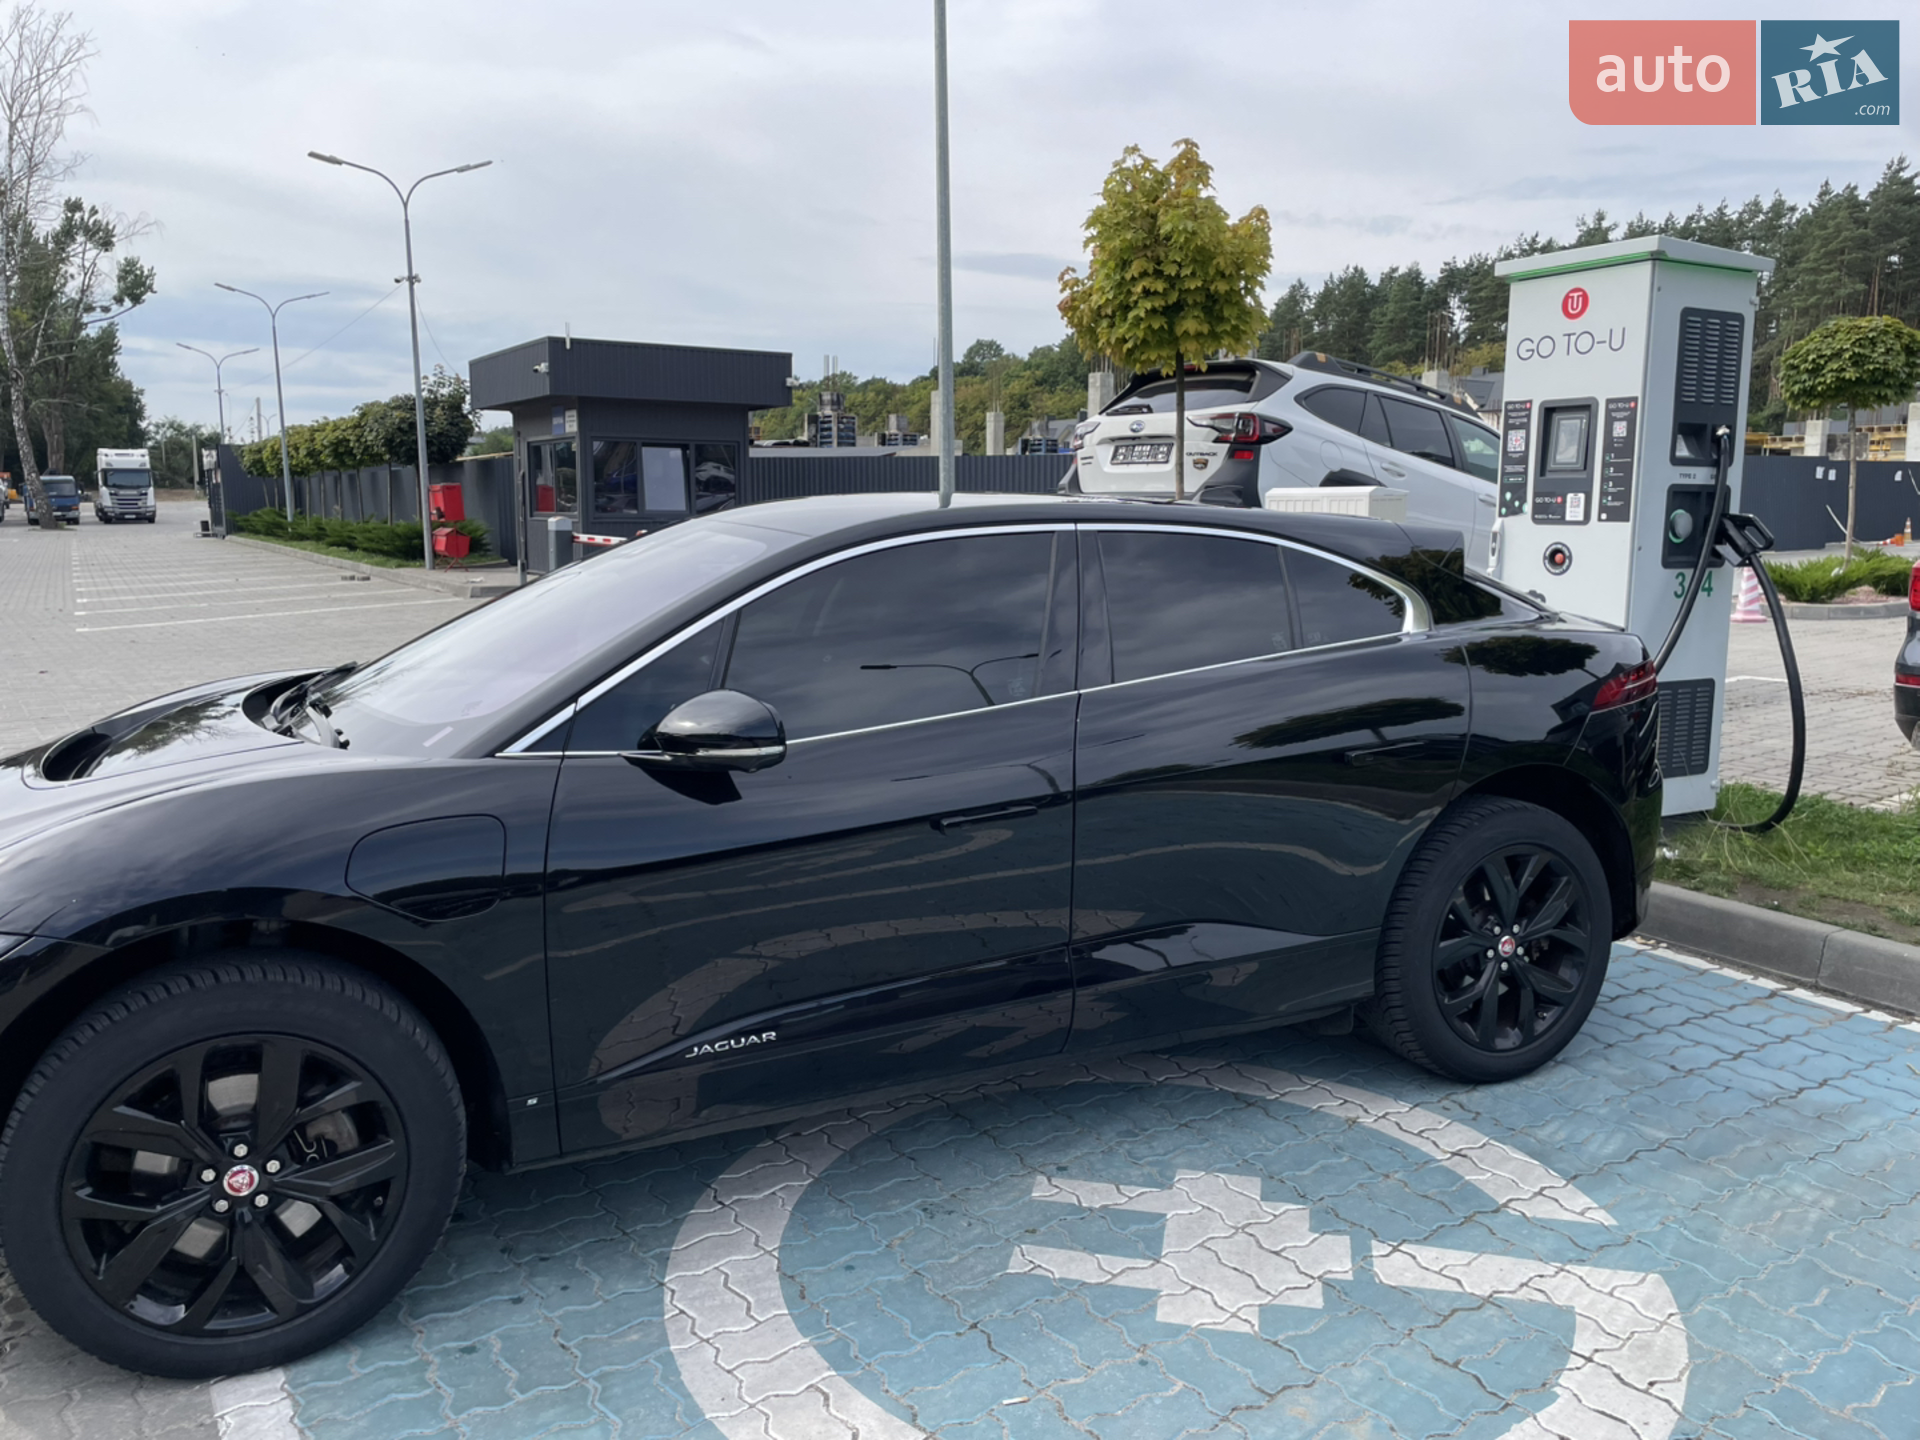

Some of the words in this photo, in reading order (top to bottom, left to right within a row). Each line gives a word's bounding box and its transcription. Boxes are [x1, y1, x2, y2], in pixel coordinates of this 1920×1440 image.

[1516, 335, 1556, 361] GO
[1562, 326, 1626, 356] TO-U
[1673, 571, 1686, 599] 3
[1700, 570, 1713, 597] 4
[685, 1031, 777, 1058] JAGUAR
